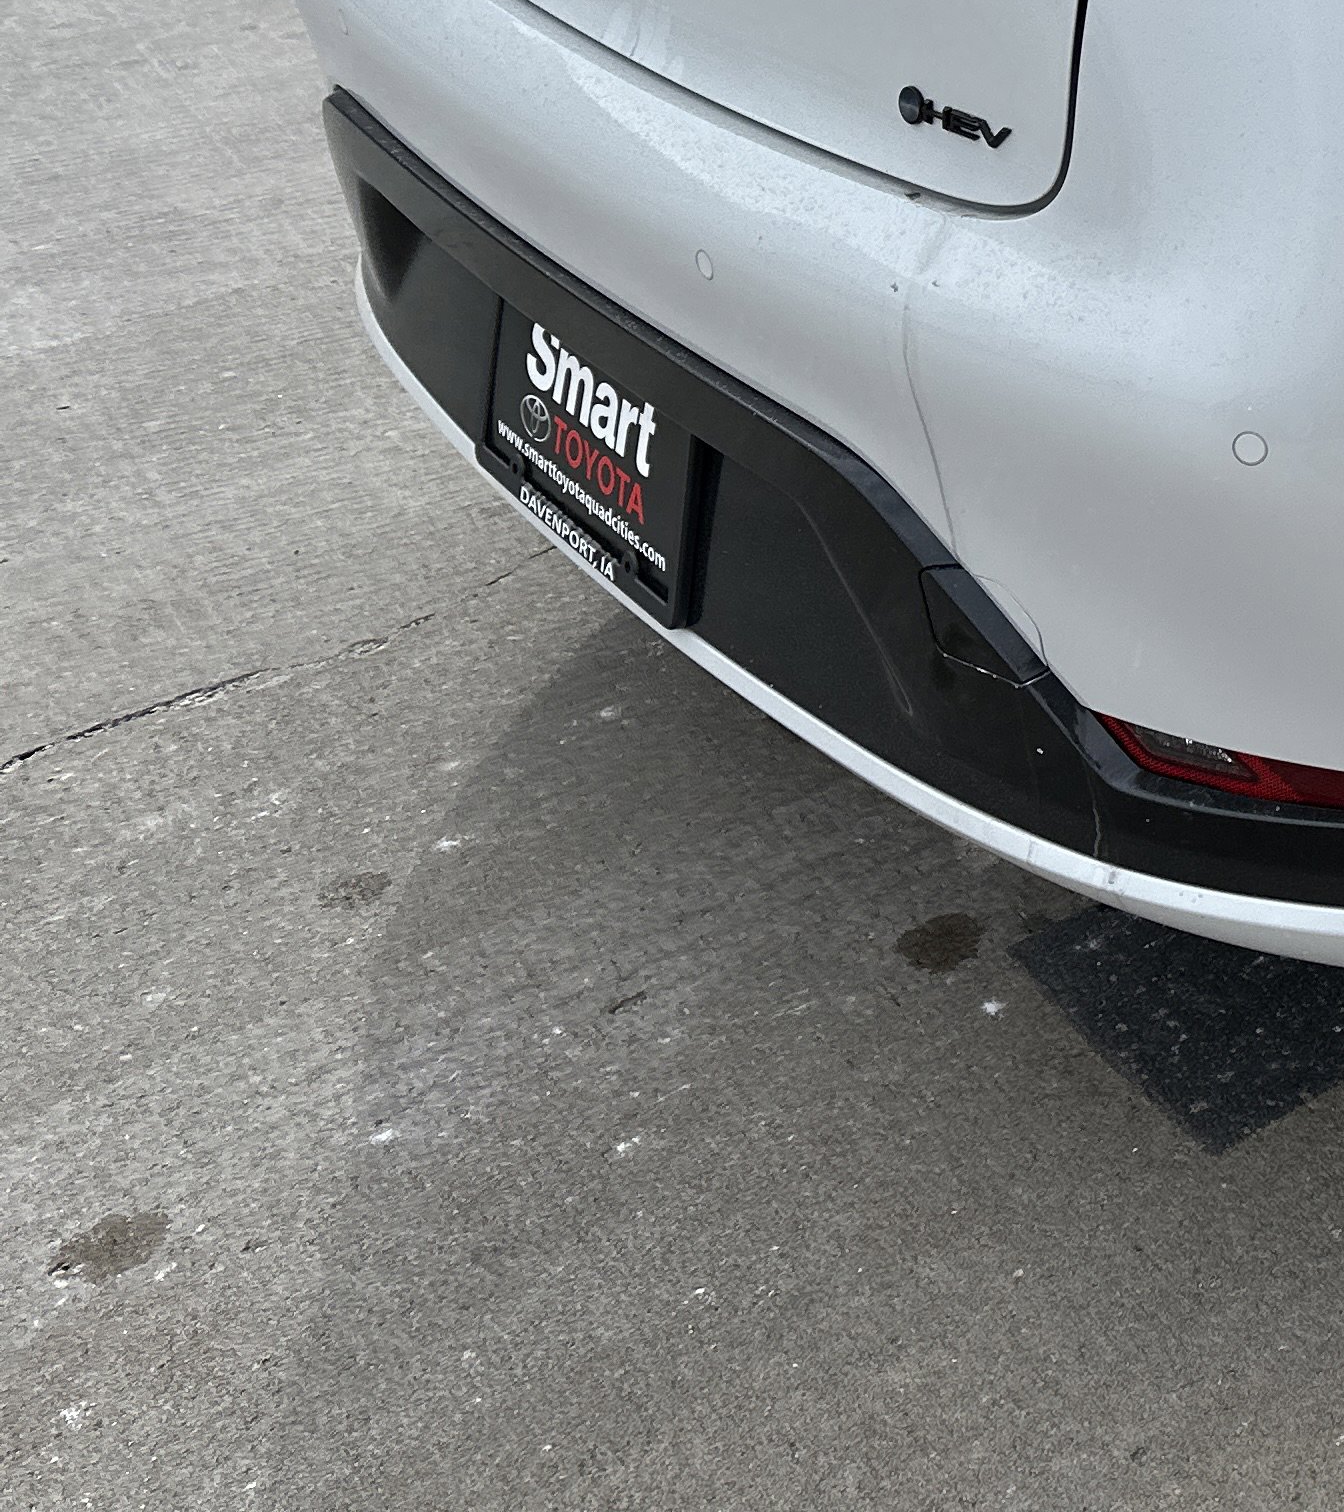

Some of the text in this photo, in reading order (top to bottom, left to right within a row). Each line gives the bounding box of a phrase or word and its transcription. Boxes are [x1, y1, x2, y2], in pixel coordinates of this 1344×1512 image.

[922, 98, 1013, 149] HEV
[526, 322, 656, 478] Smart
[497, 419, 666, 572] www.smarttoyotaquadcities.com
[553, 415, 645, 525] TOYOTA
[520, 486, 614, 581] DAVENPORT, IA
